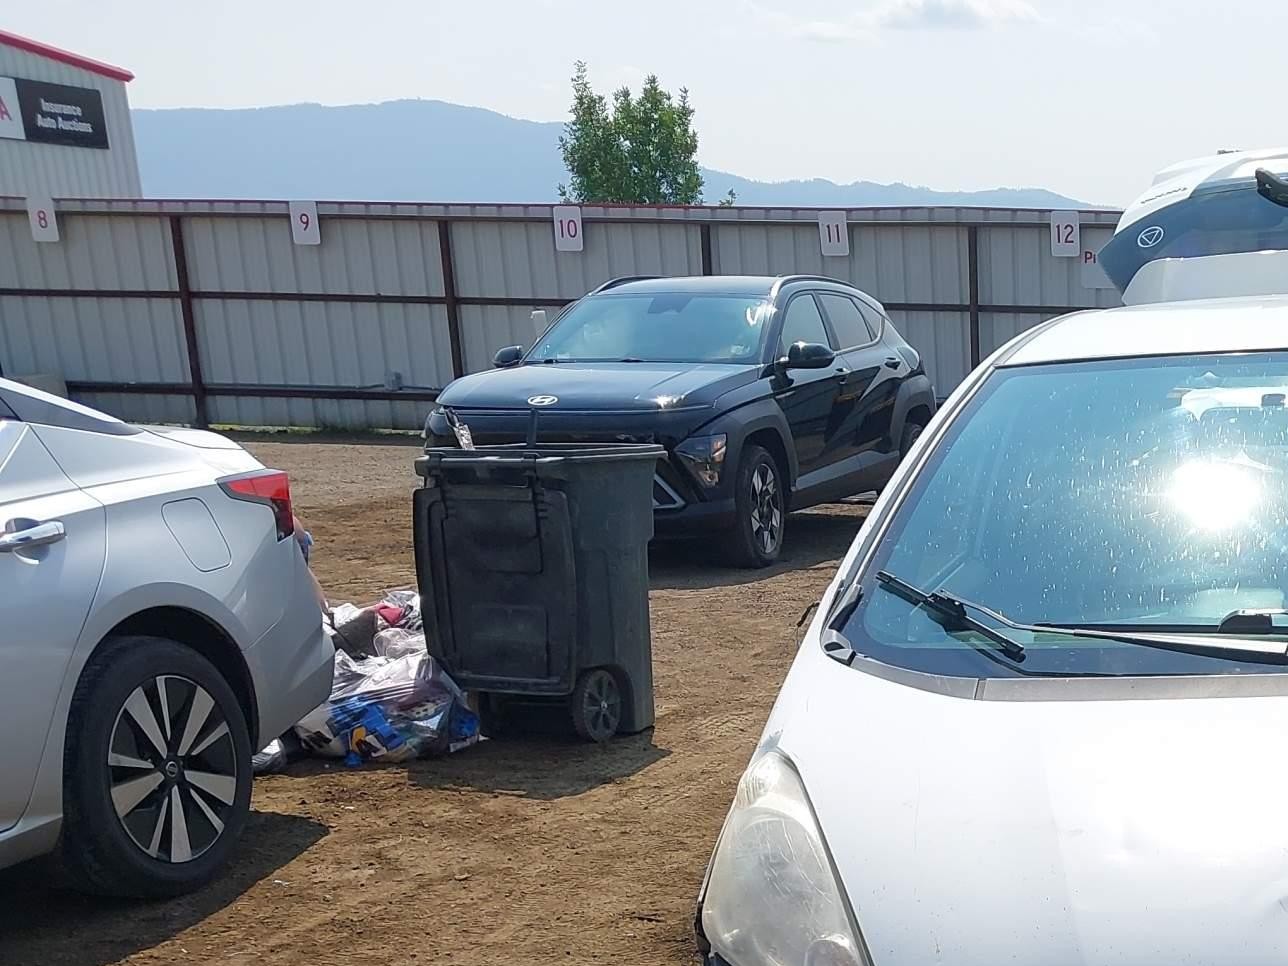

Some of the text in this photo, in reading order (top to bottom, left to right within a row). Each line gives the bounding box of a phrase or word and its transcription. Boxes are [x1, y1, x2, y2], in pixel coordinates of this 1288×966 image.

[37, 210, 48, 229] 8
[300, 213, 309, 231] 9
[560, 219, 577, 238] 10
[826, 223, 840, 243] 11
[1056, 224, 1074, 243] 12
